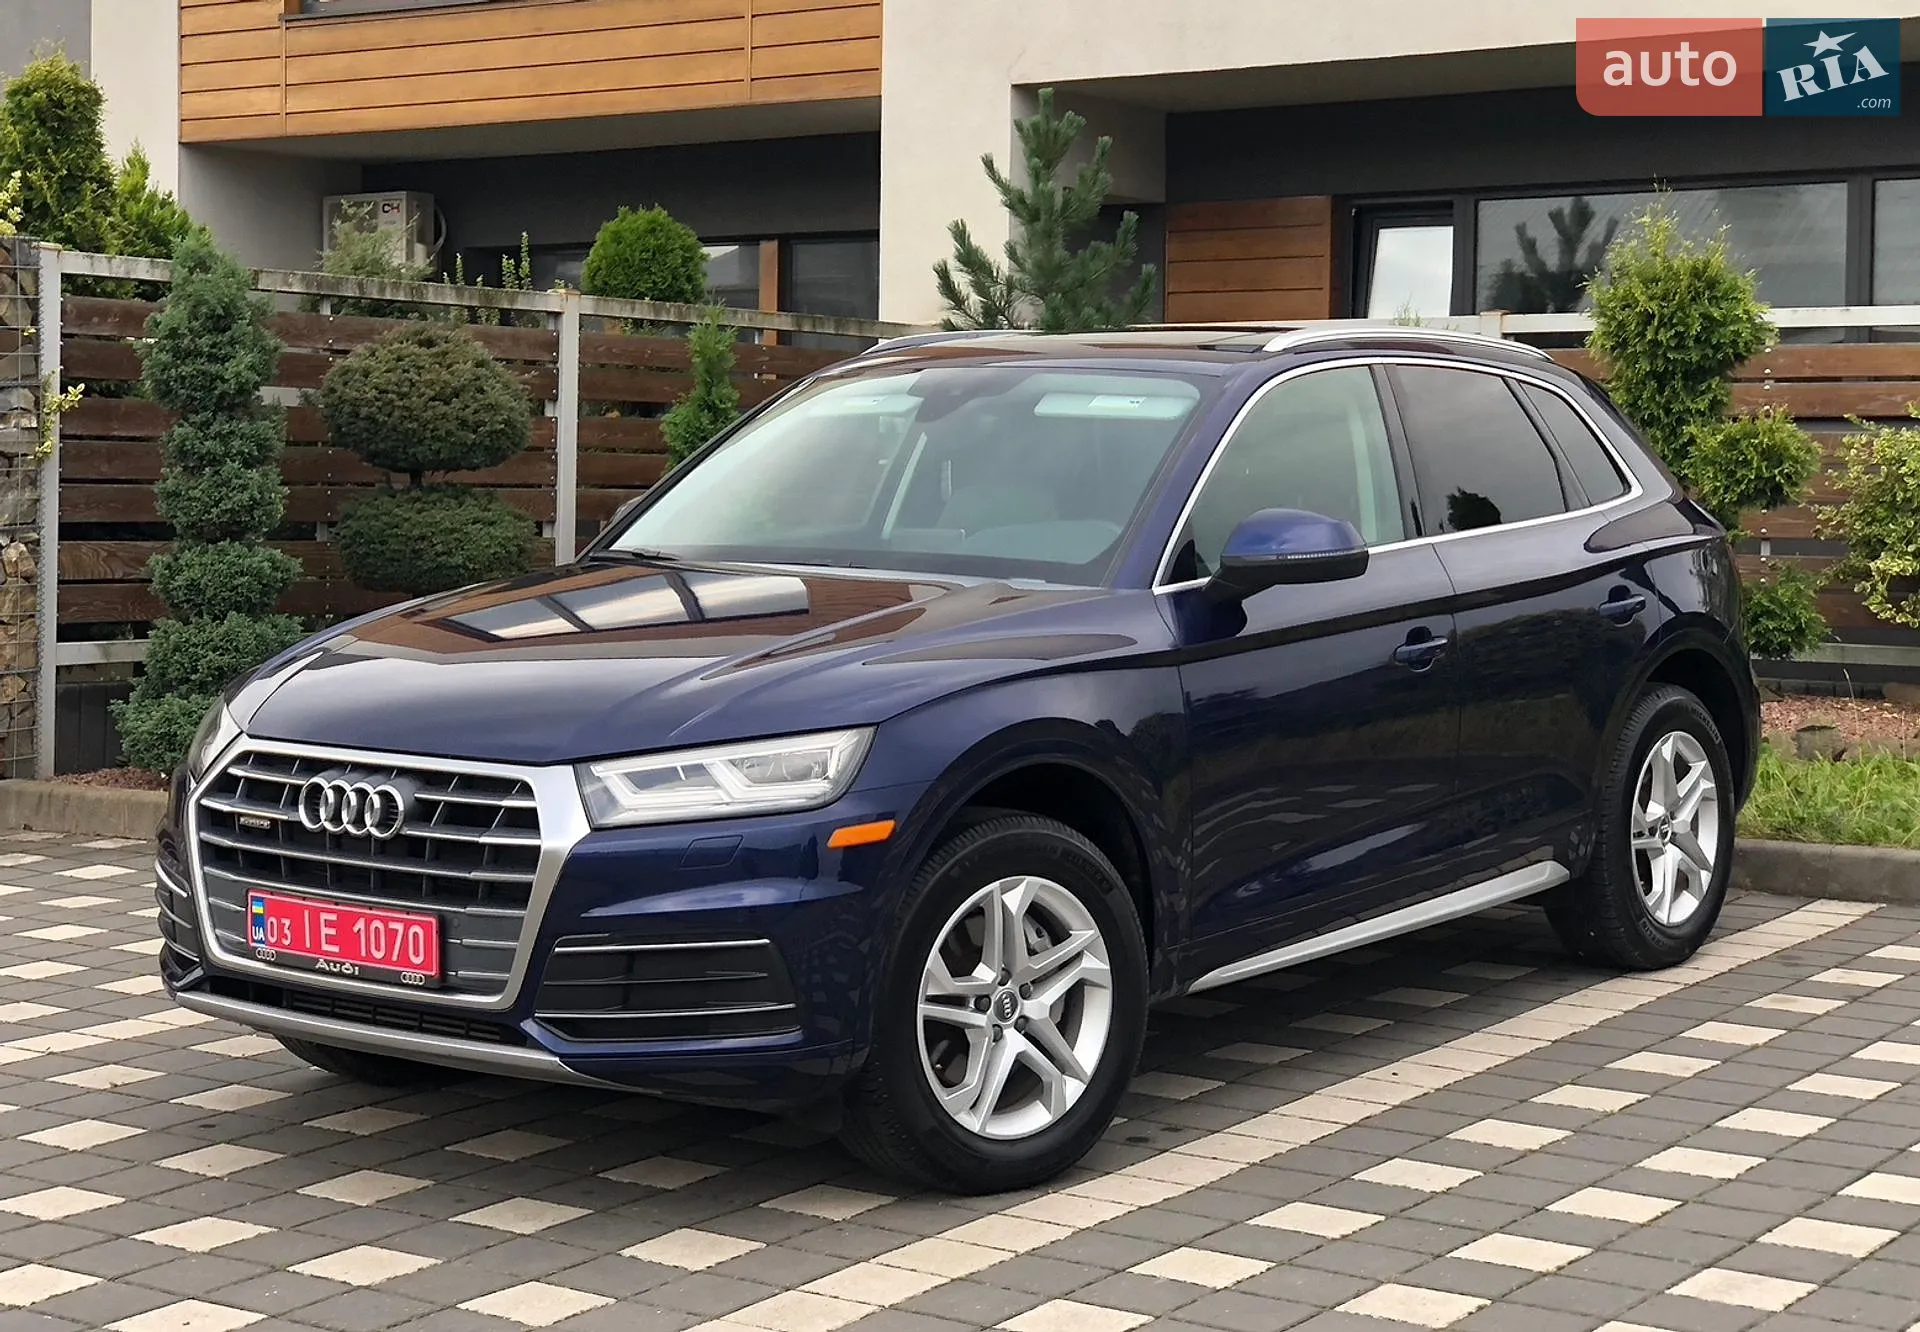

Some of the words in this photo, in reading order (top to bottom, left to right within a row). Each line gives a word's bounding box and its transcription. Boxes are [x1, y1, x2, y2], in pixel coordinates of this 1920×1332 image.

[252, 925, 265, 942] UA
[267, 916, 292, 946] 03
[304, 909, 340, 953] IE
[352, 917, 425, 965] 1070
